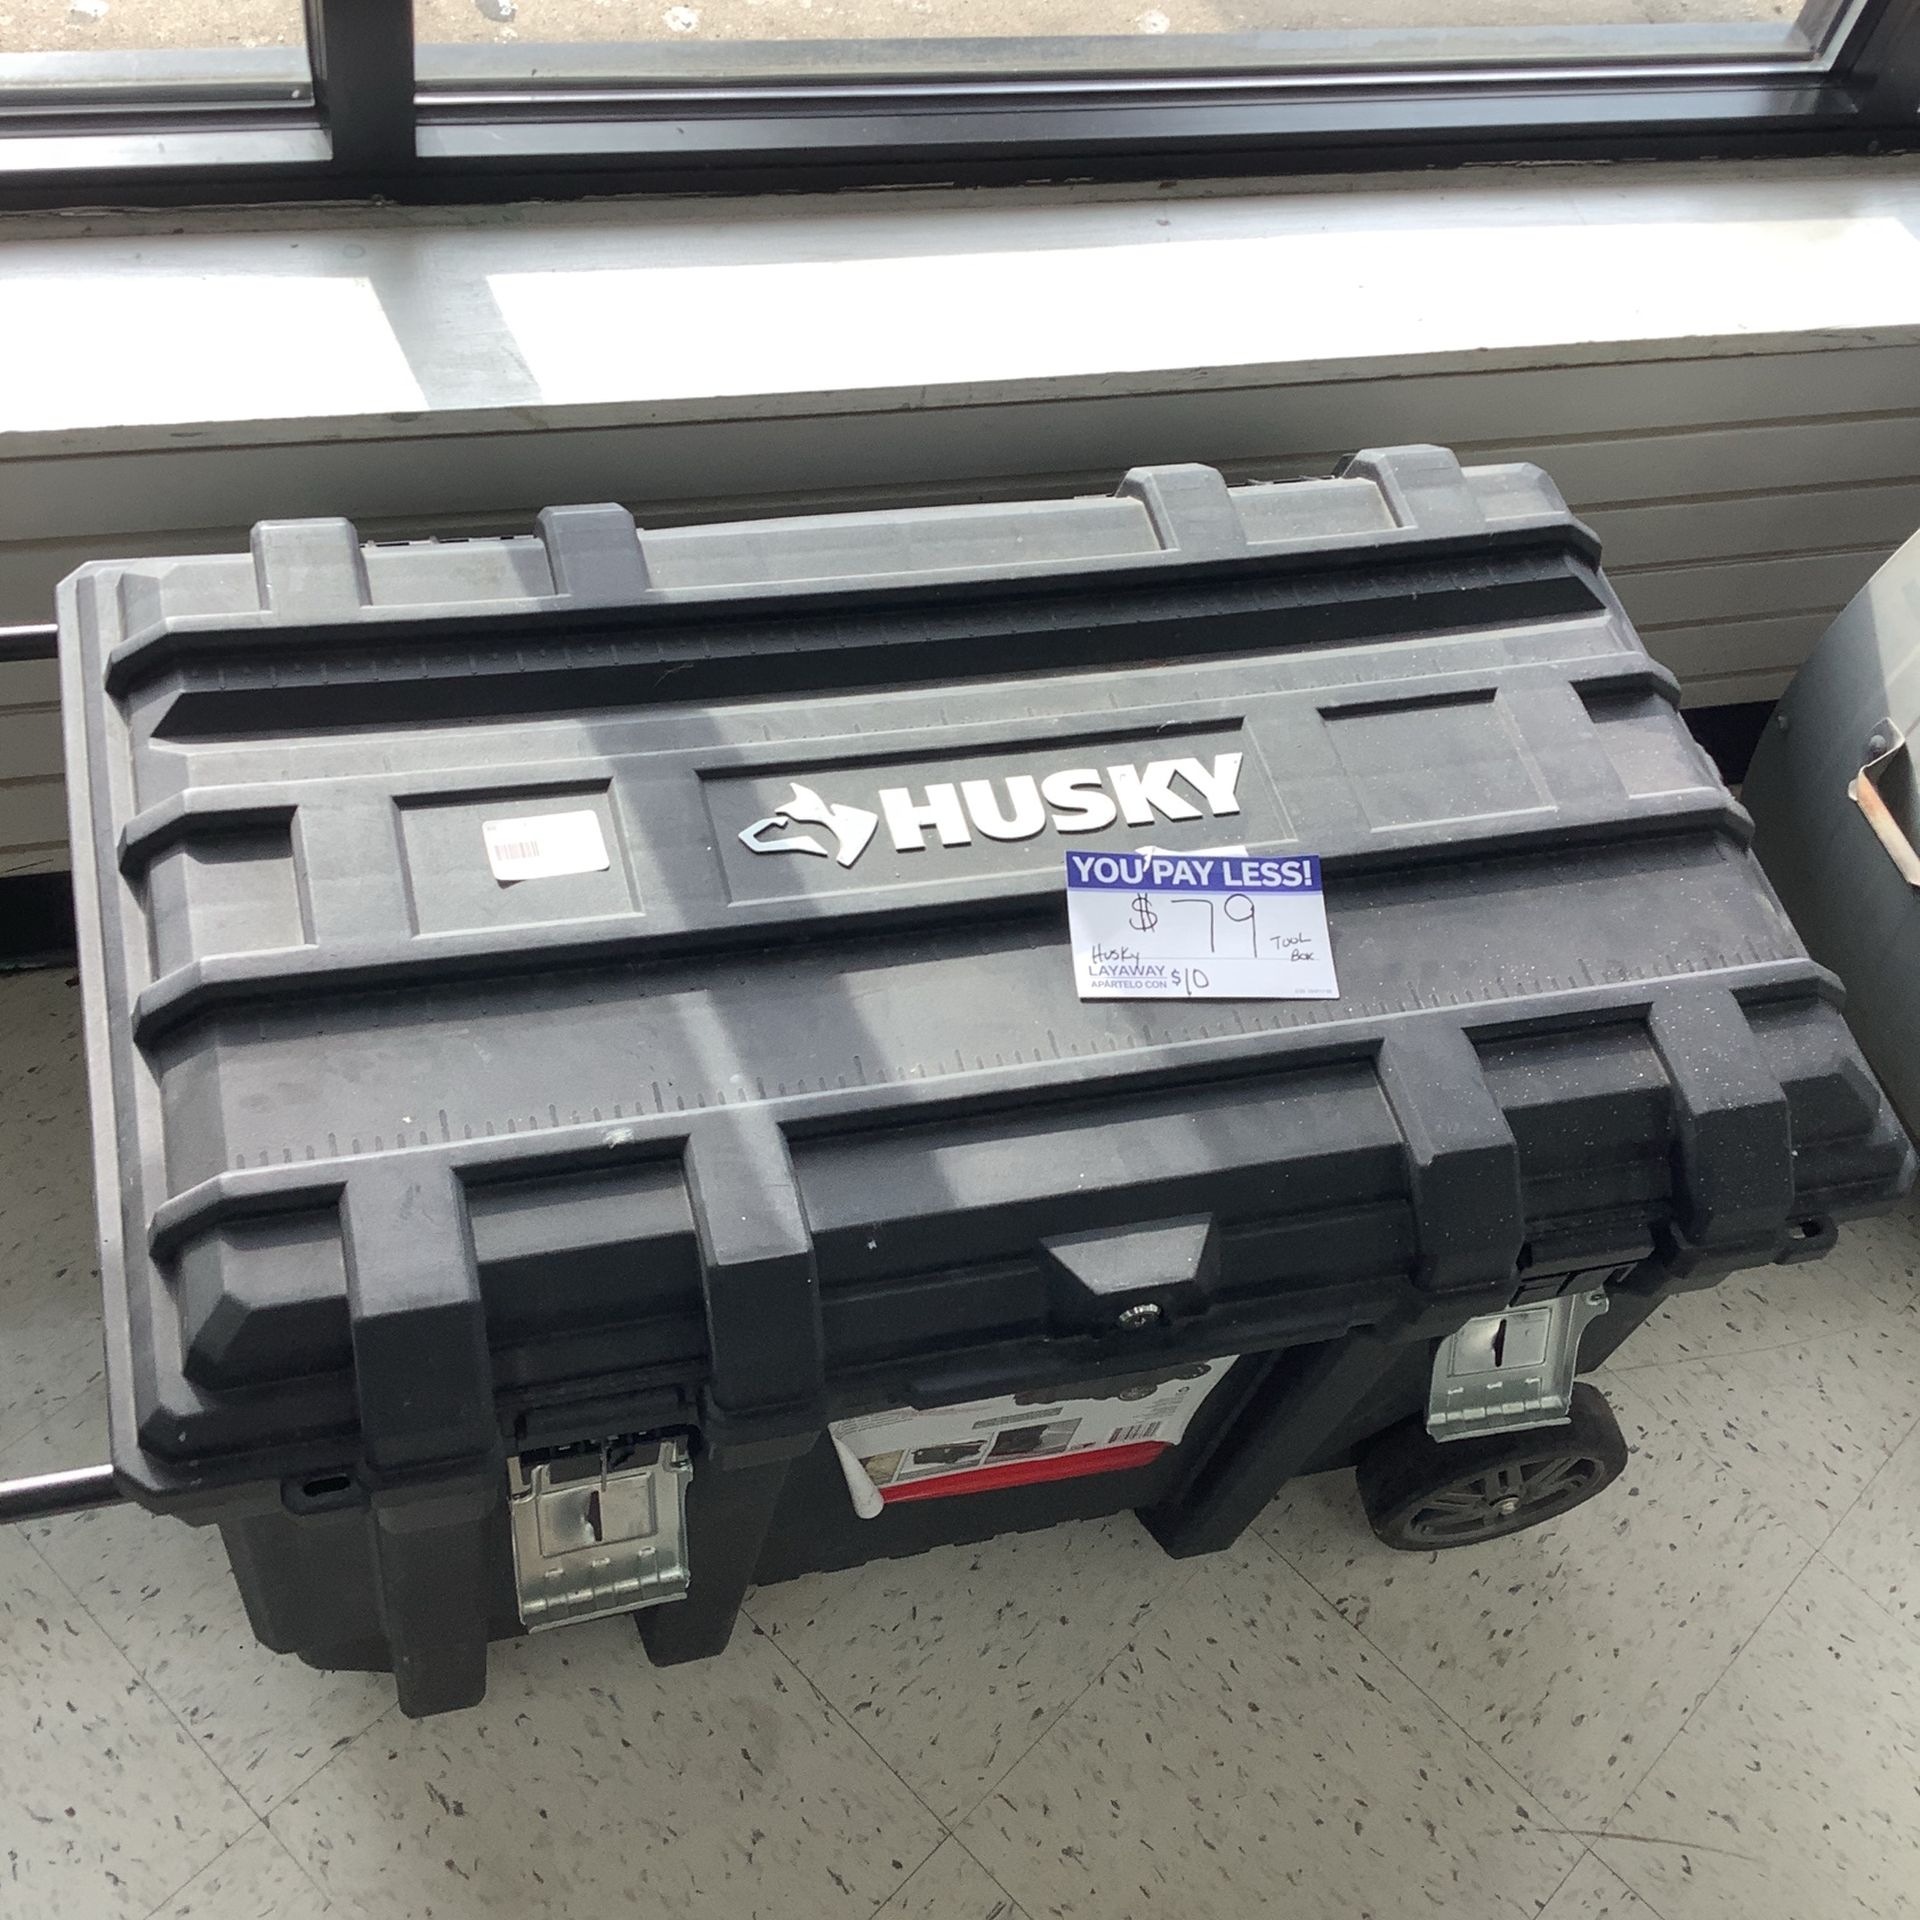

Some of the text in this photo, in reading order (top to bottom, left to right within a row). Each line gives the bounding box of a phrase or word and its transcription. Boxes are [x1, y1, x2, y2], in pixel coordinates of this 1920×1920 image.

[878, 752, 1243, 851] HUSKY
[1072, 855, 1313, 887] YOU PAY LESS!
[1129, 892, 1257, 958] $79
[1088, 965, 1166, 977] LAYAWAY
[1145, 980, 1168, 989] CON
[1171, 968, 1210, 996] $10
